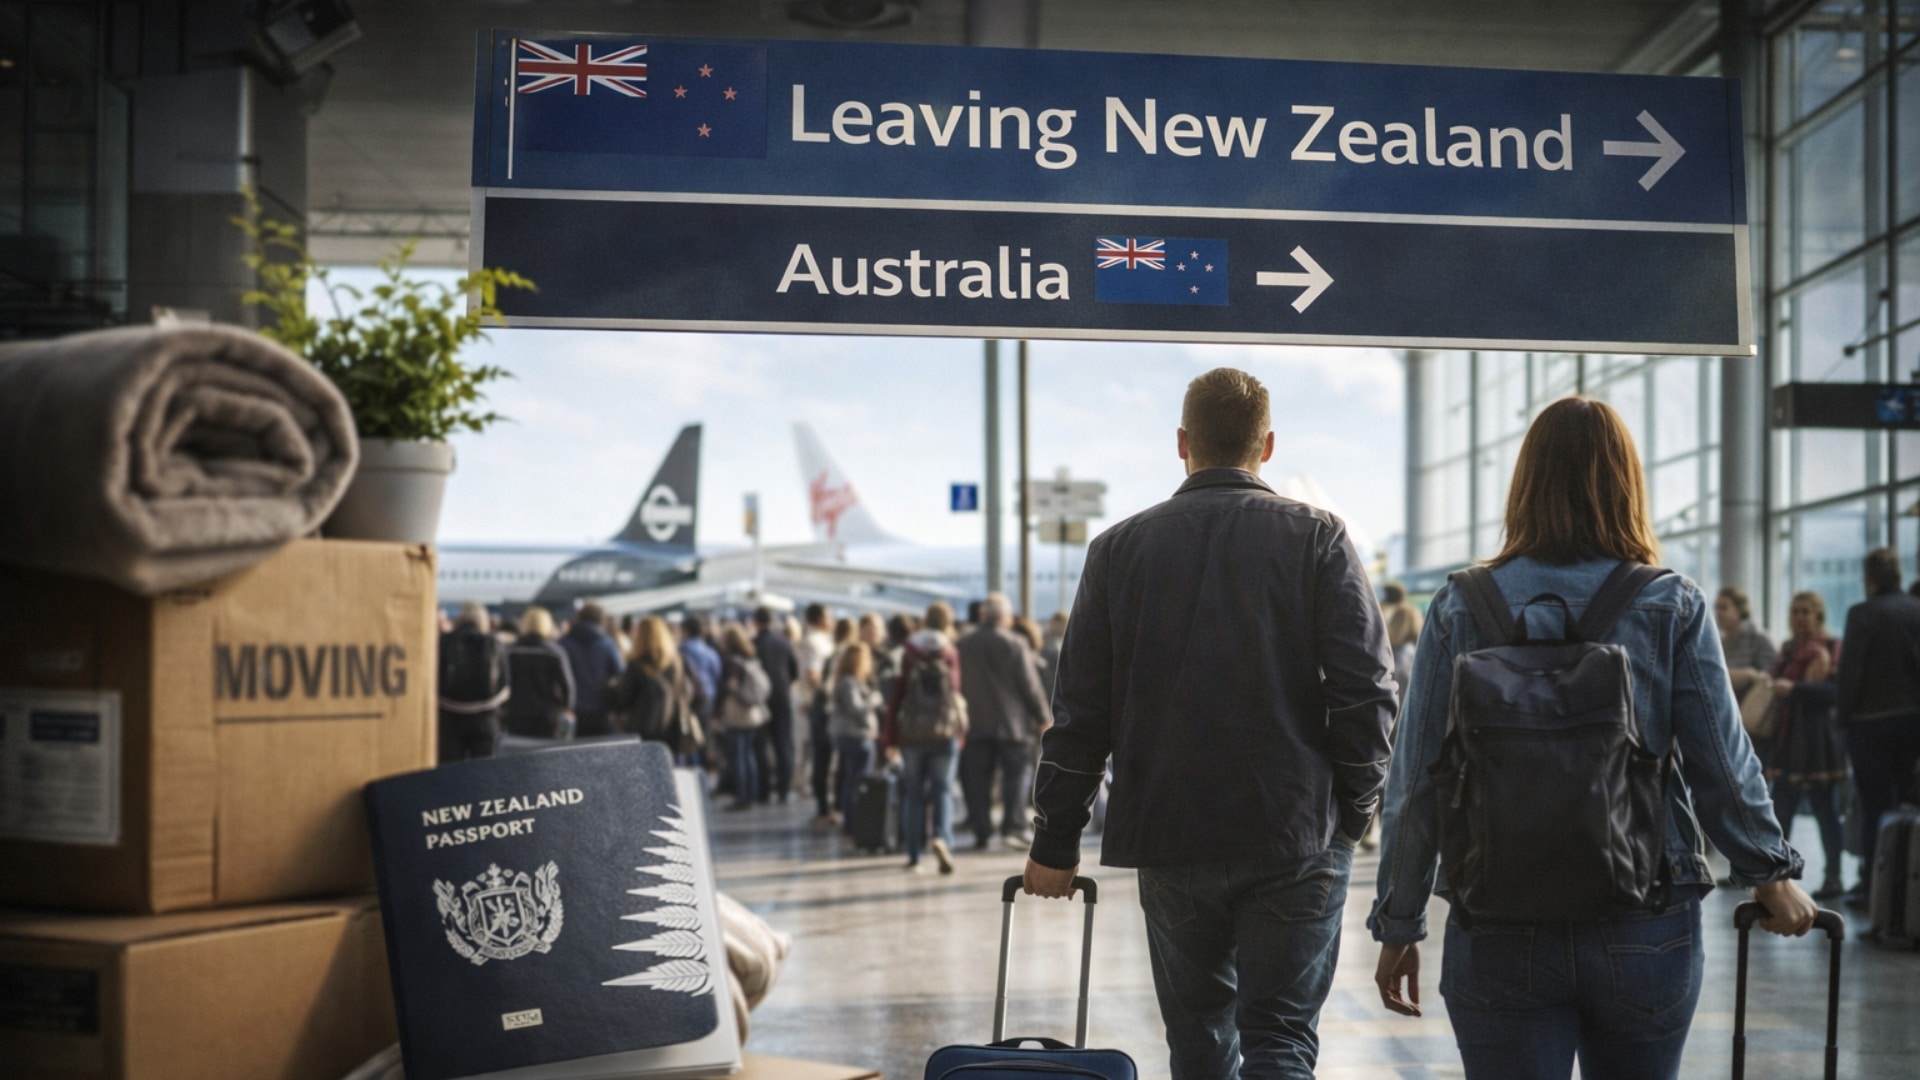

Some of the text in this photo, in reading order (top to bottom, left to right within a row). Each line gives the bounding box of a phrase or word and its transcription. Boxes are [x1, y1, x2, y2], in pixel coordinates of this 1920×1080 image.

[792, 84, 1573, 171] Leaving New Zealand
[776, 243, 1070, 301] Australia
[215, 645, 406, 700] MOVING
[422, 787, 585, 828] NEW ZEALAND
[425, 817, 536, 850] PASSPORT
